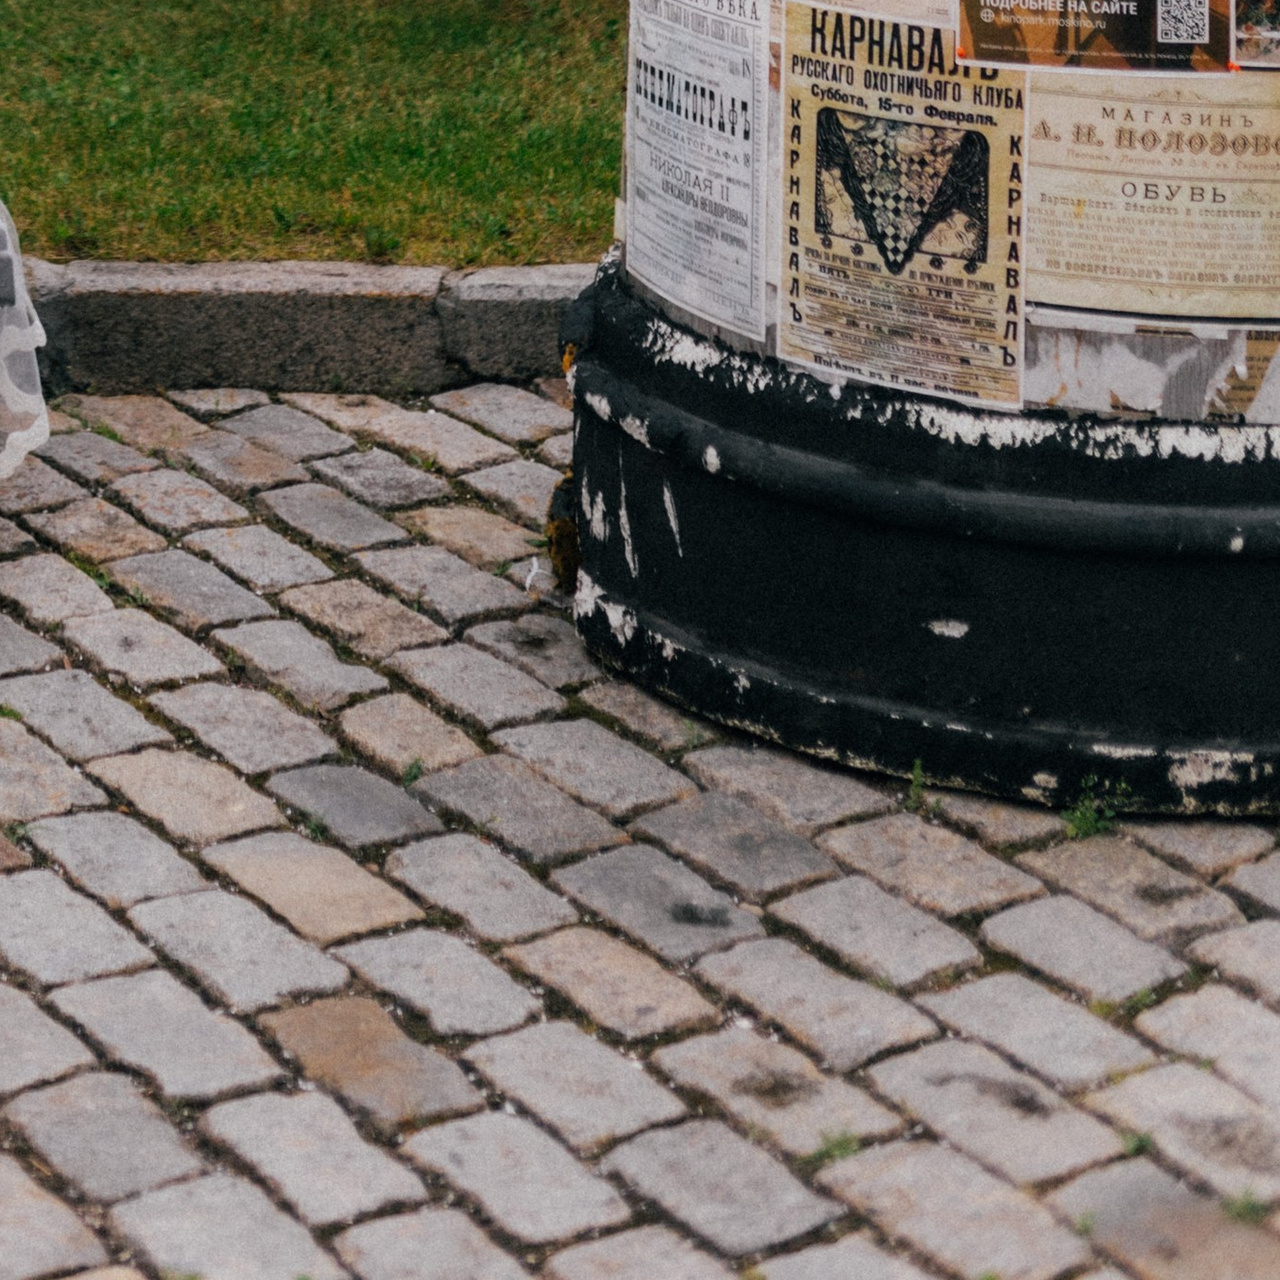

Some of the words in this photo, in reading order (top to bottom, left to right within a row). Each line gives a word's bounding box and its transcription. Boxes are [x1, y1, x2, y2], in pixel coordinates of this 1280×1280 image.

[1000, 13, 1106, 30] kinopark.moskino.ru
[1068, 0, 1088, 13] НА
[811, 8, 999, 80] КАРНАВА
[792, 54, 854, 86] РУССКАГО
[864, 70, 961, 102] ОХОТНИЧЬЯГО
[973, 84, 1024, 110] КЛУБА
[811, 83, 868, 109] Суббота,
[878, 97, 914, 115] 15-го
[924, 105, 997, 126] Февраля.
[1101, 107, 1253, 128] МАГАЗИНЪ
[650, 150, 713, 196] НИКОЛАЯ
[1122, 182, 1226, 203] ОБУВЬ
[789, 97, 803, 323] КАРНАВАЛЪ
[1001, 135, 1022, 366] КАРНАВАЛЪ
